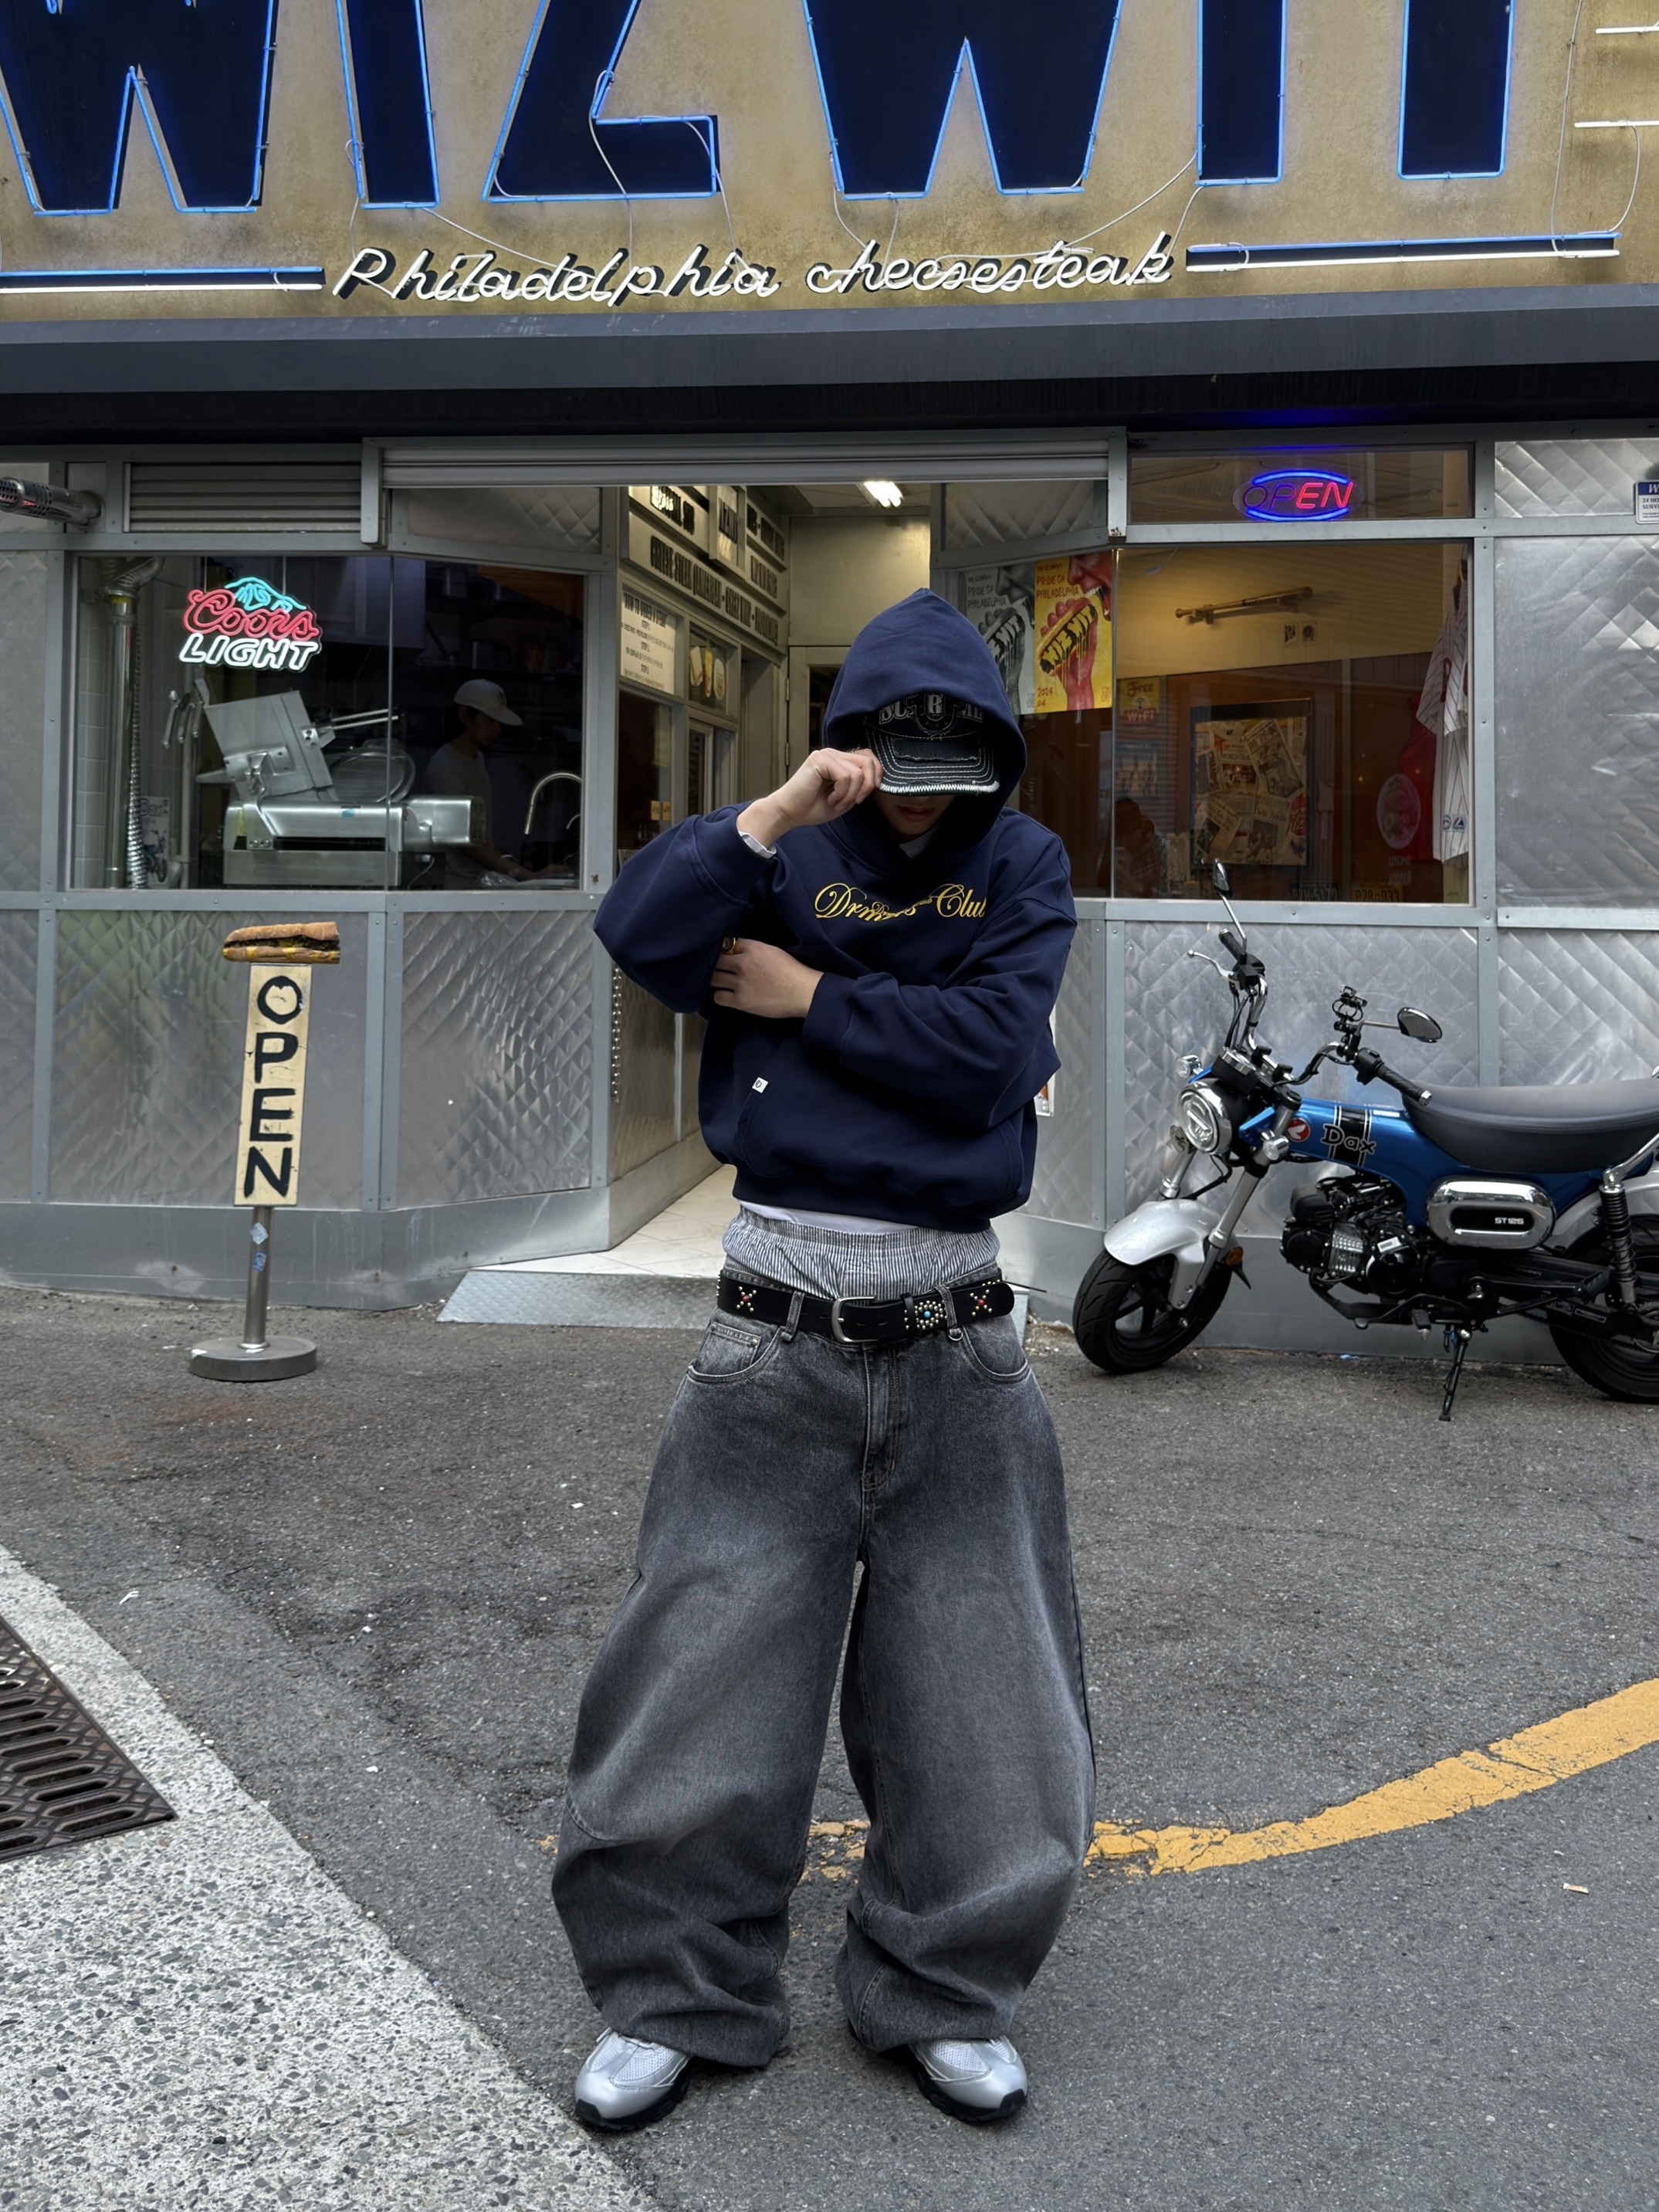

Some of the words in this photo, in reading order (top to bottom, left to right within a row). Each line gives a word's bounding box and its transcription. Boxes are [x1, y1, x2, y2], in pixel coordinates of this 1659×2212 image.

[1243, 481, 1353, 511] OPEN
[1037, 575, 1055, 585] PRIDE
[1057, 574, 1066, 583] OF
[968, 587, 985, 596] PRIDE
[1037, 587, 1079, 599] PHILADELPHIA
[968, 597, 1007, 608] PHILADELPHIA
[183, 589, 319, 642] Coors
[178, 632, 318, 670] LIGHT
[1037, 686, 1053, 697] 2024
[1127, 680, 1154, 696] Free
[244, 976, 303, 1197] OPEN
[1320, 1123, 1376, 1154] Dax
[1495, 1217, 1525, 1225] ST125
